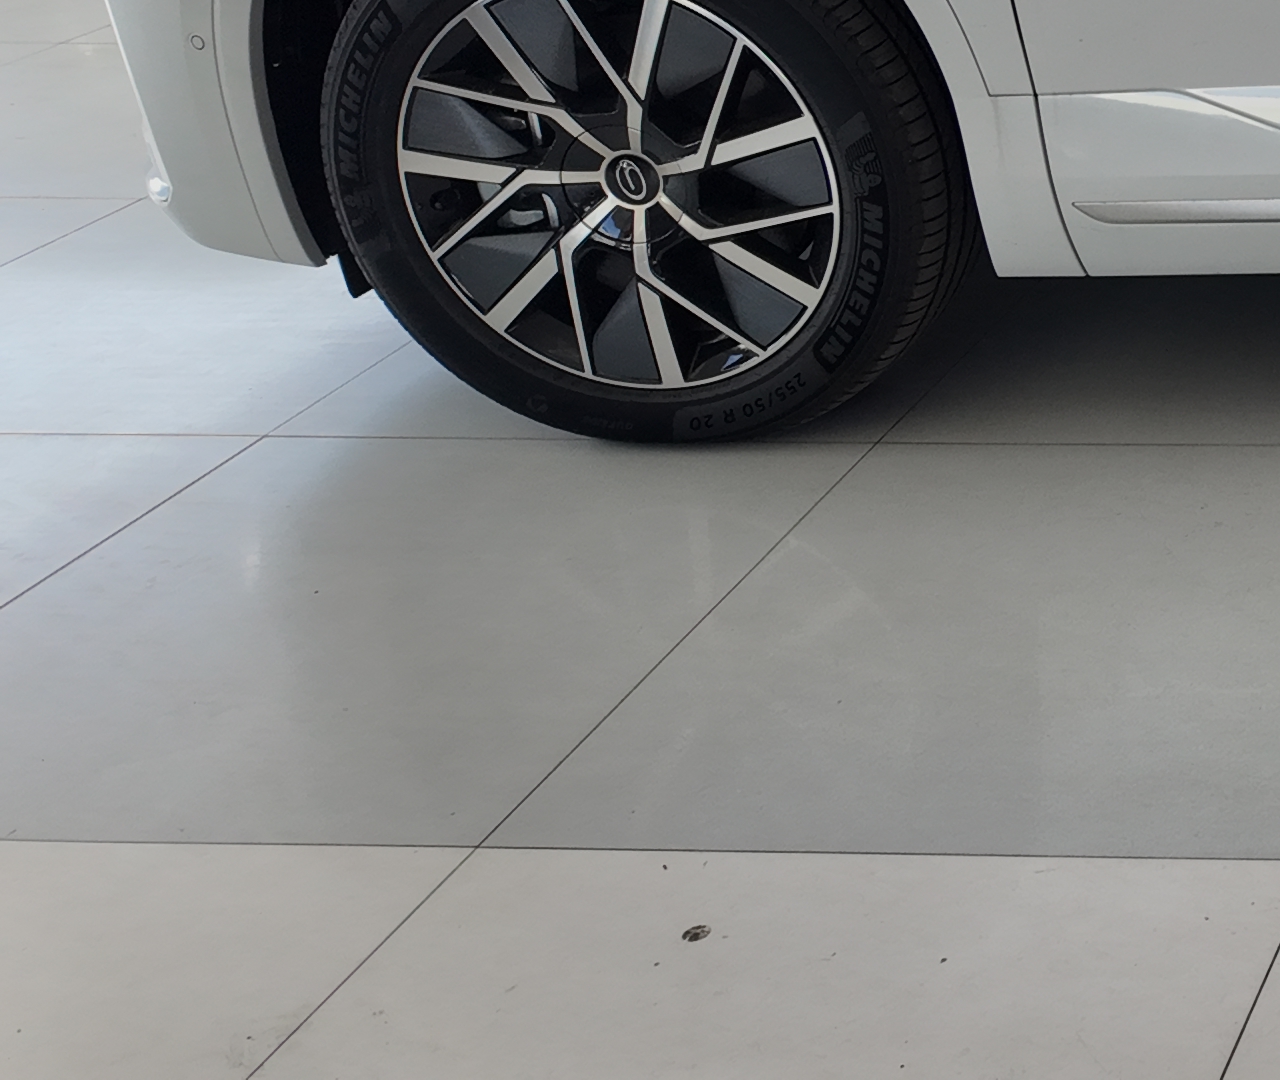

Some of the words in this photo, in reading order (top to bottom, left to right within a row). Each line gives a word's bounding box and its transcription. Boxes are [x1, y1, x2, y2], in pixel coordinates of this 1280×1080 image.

[337, 8, 394, 182] MICHELIN
[819, 200, 884, 367] MICHELIN
[722, 408, 734, 422] R
[742, 372, 806, 417] 255/50
[689, 414, 713, 432] 20
